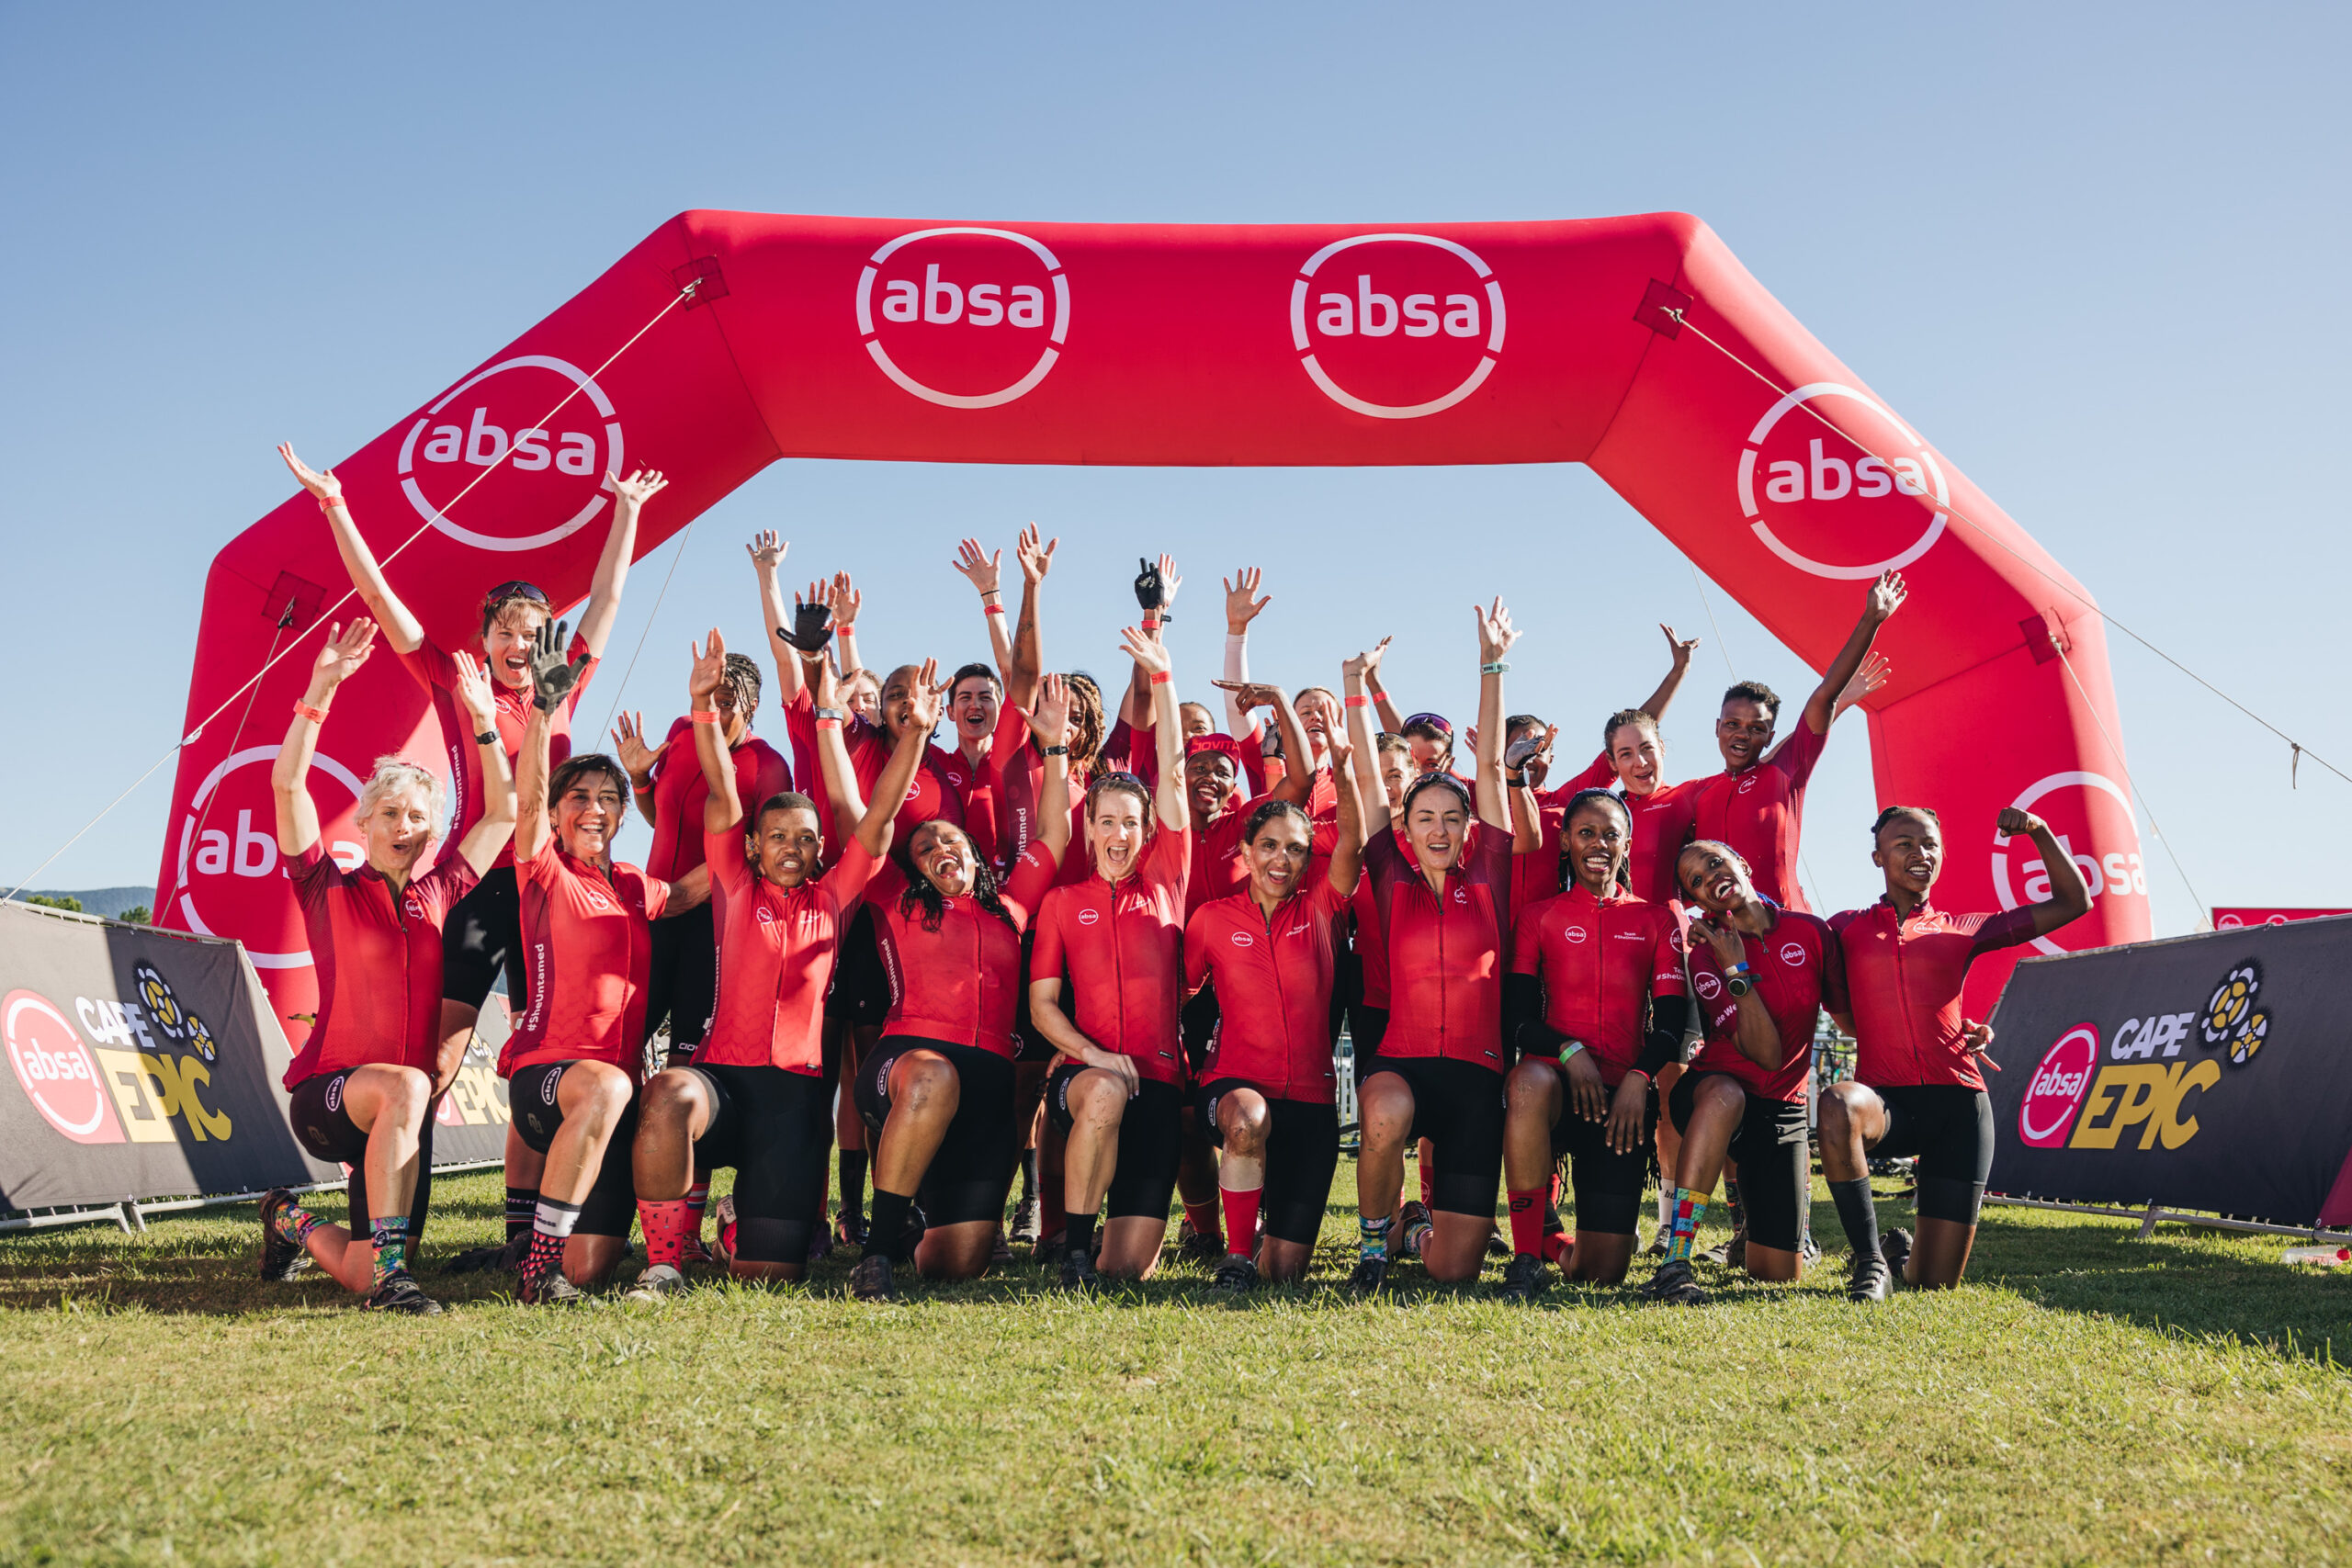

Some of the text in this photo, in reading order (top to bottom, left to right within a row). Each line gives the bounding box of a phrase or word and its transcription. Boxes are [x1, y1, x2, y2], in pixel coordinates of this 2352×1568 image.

[882, 264, 1044, 327] absa
[1317, 275, 1480, 337] absa
[424, 407, 596, 476] absa
[1764, 438, 1926, 503] absa
[196, 809, 366, 878] aba
[1784, 950, 1803, 959] absa
[527, 943, 545, 1032] #SheUntamed
[75, 996, 156, 1048] CAPE
[2111, 1011, 2197, 1060] CAPE
[23, 1038, 91, 1080] absa
[2034, 1061, 2082, 1098] absa
[95, 1047, 232, 1143] EPIC
[2068, 1058, 2222, 1151] EPIC
